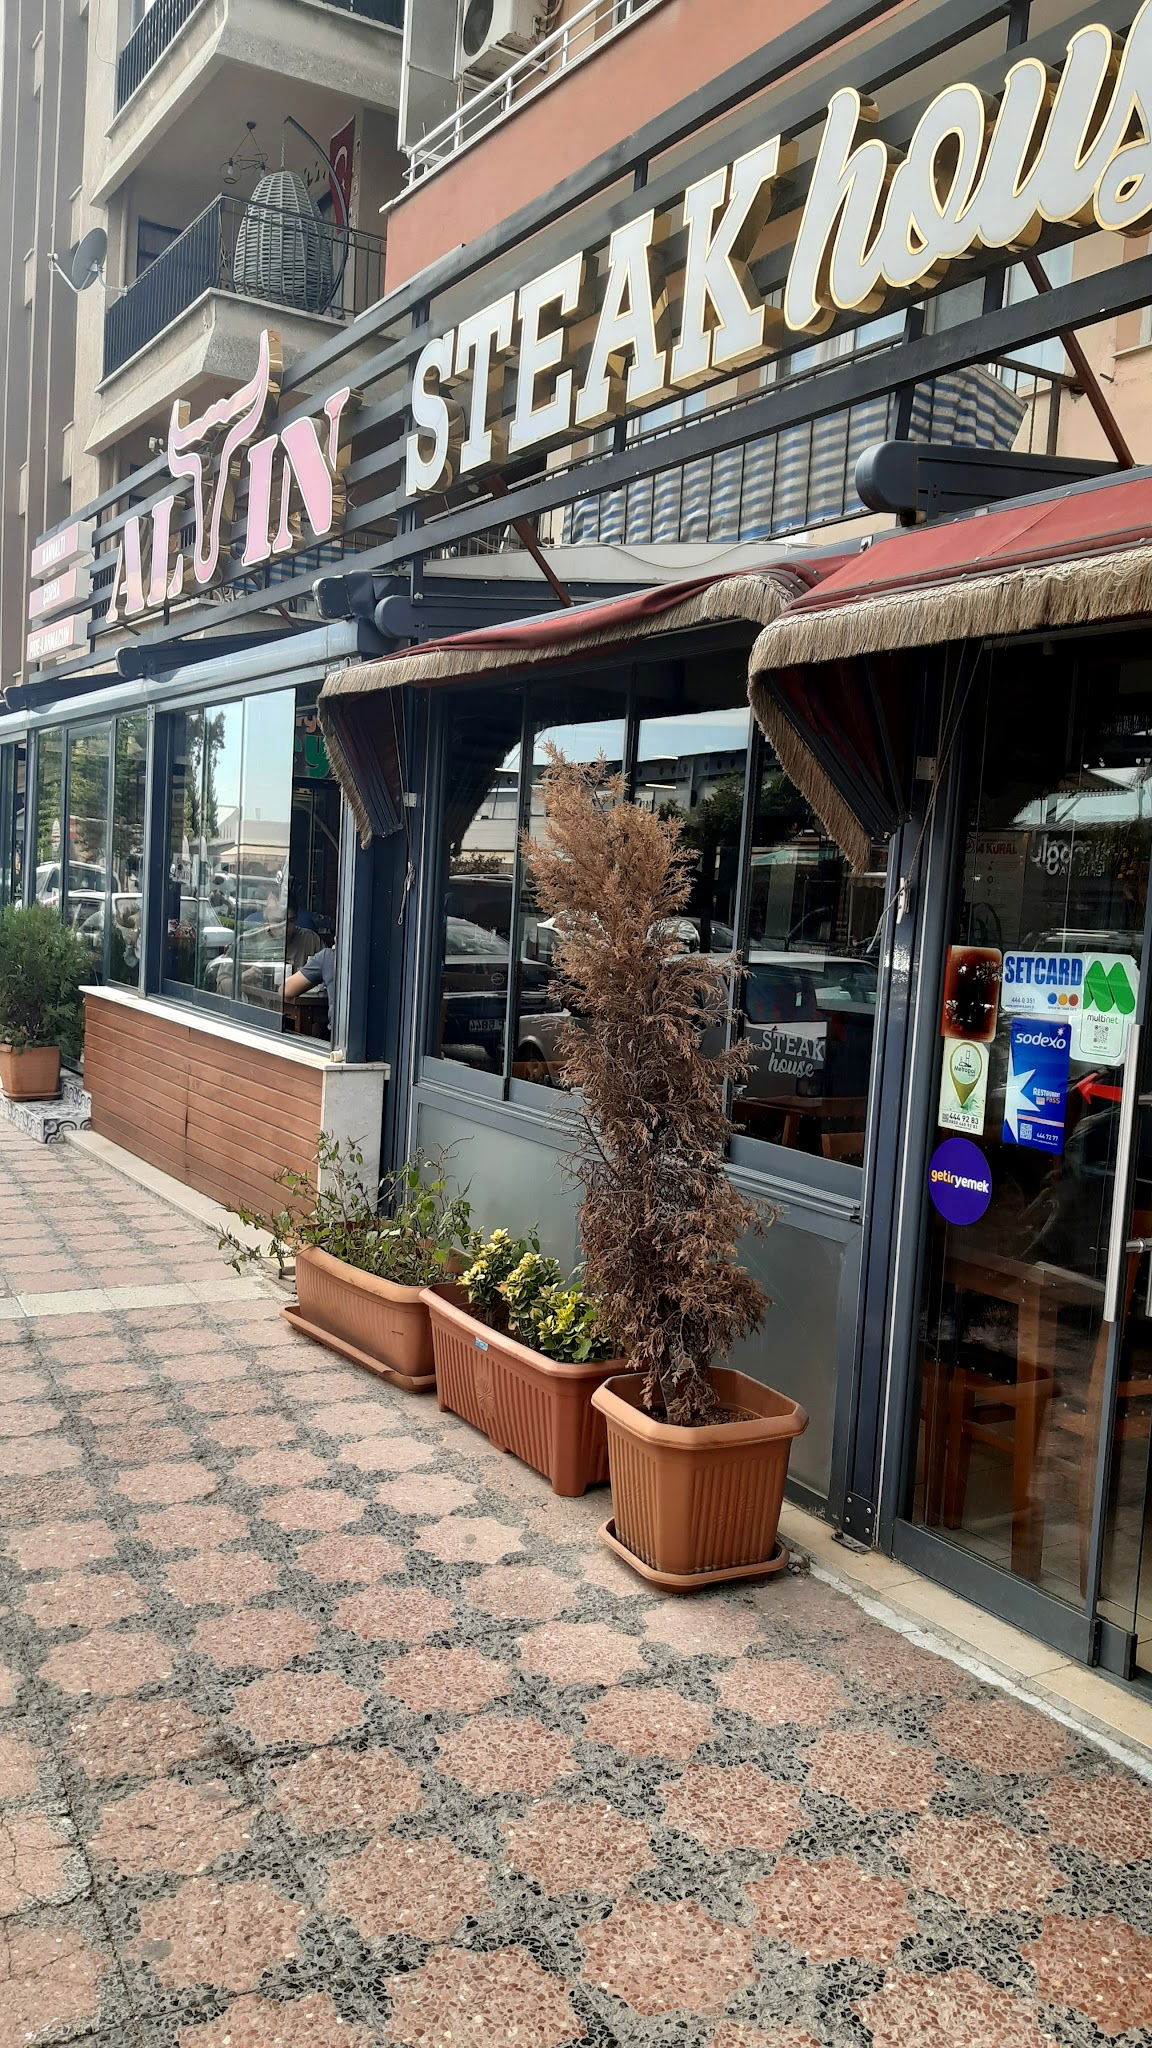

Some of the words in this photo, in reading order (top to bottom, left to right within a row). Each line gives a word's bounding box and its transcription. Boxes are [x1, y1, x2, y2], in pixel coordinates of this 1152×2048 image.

[405, 134, 781, 497] STEAK
[1004, 956, 1083, 986] SETCARD
[1086, 1014, 1119, 1025] multinet
[762, 1030, 826, 1062] STEAK
[1015, 1032, 1067, 1050] sodexo
[768, 1052, 815, 1078] house
[949, 1112, 961, 1121] 444
[971, 1117, 979, 1125] 83
[931, 1169, 990, 1194] getiryemek
